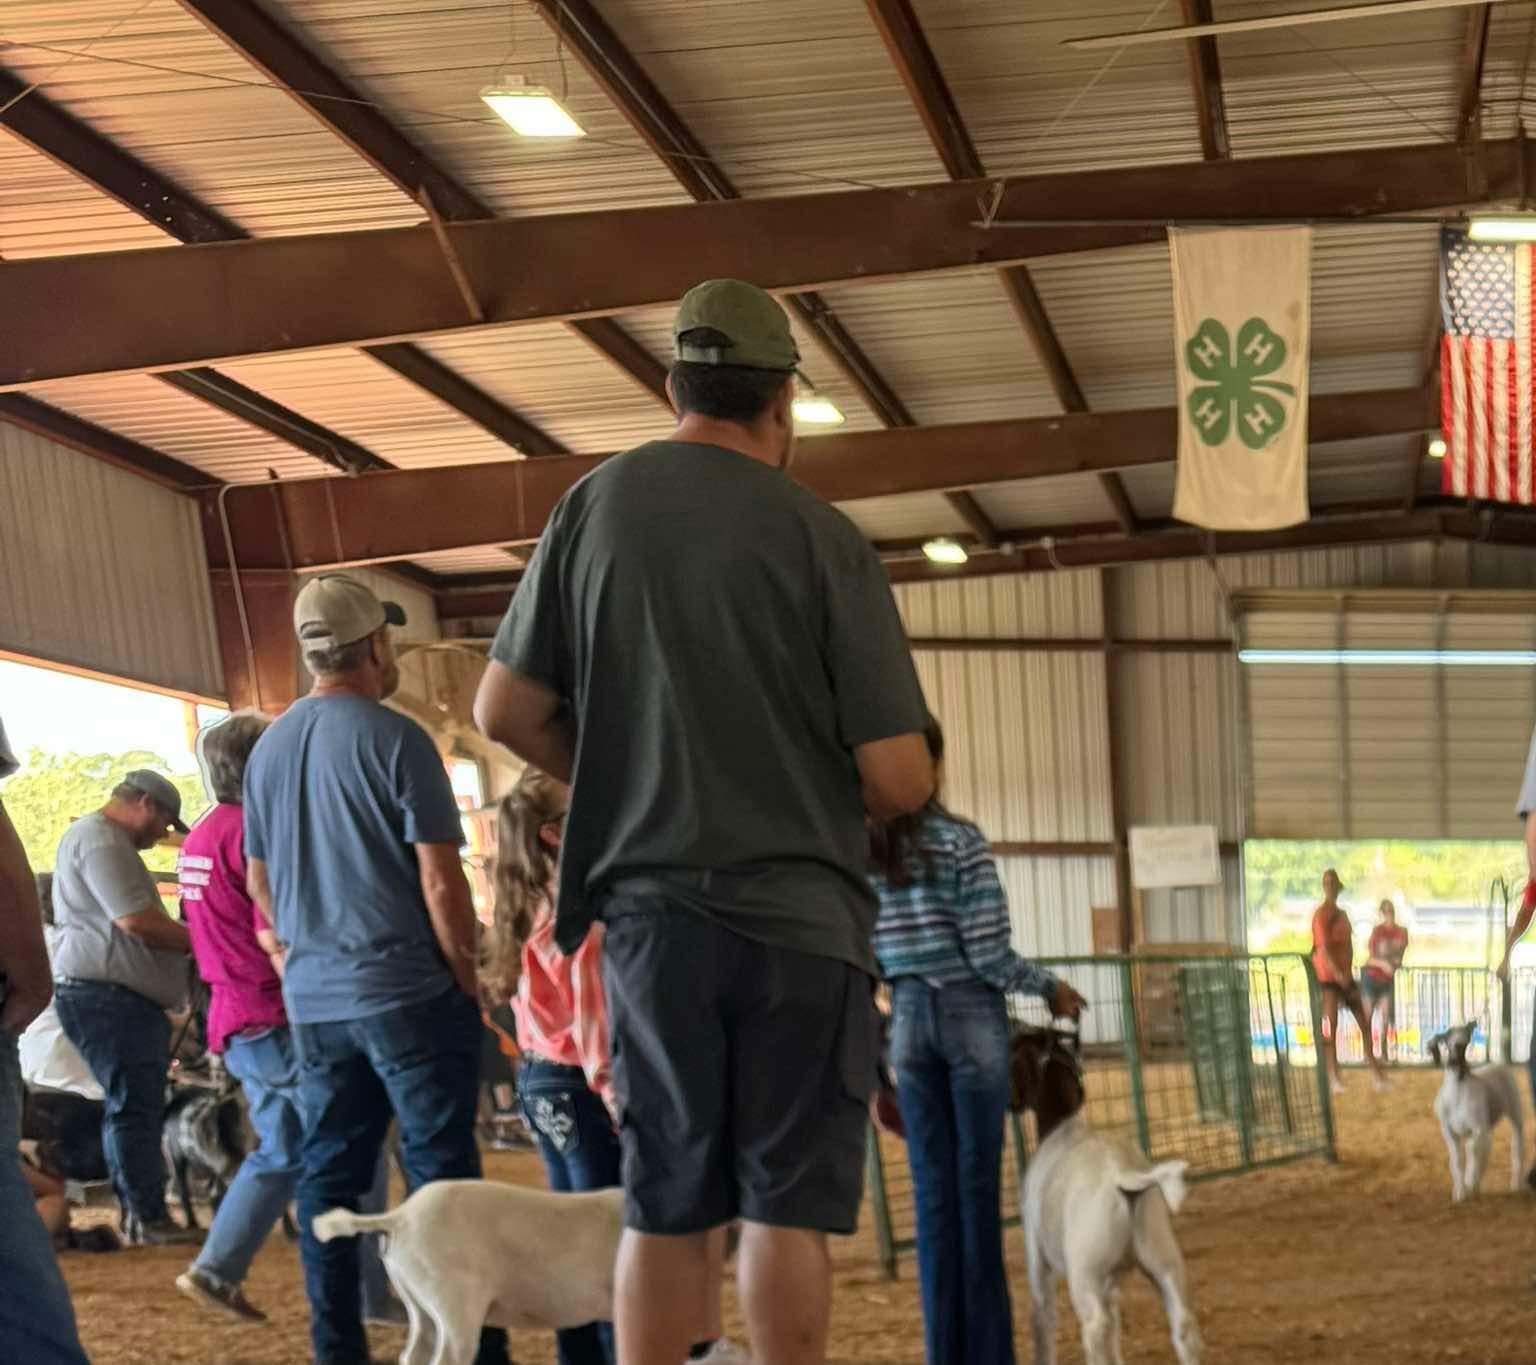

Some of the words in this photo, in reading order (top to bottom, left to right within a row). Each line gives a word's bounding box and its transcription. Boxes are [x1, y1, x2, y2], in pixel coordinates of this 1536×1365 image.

[1194, 336, 1222, 368] H
[1243, 333, 1274, 366] H
[1195, 399, 1223, 429] H
[1243, 403, 1274, 434] H
